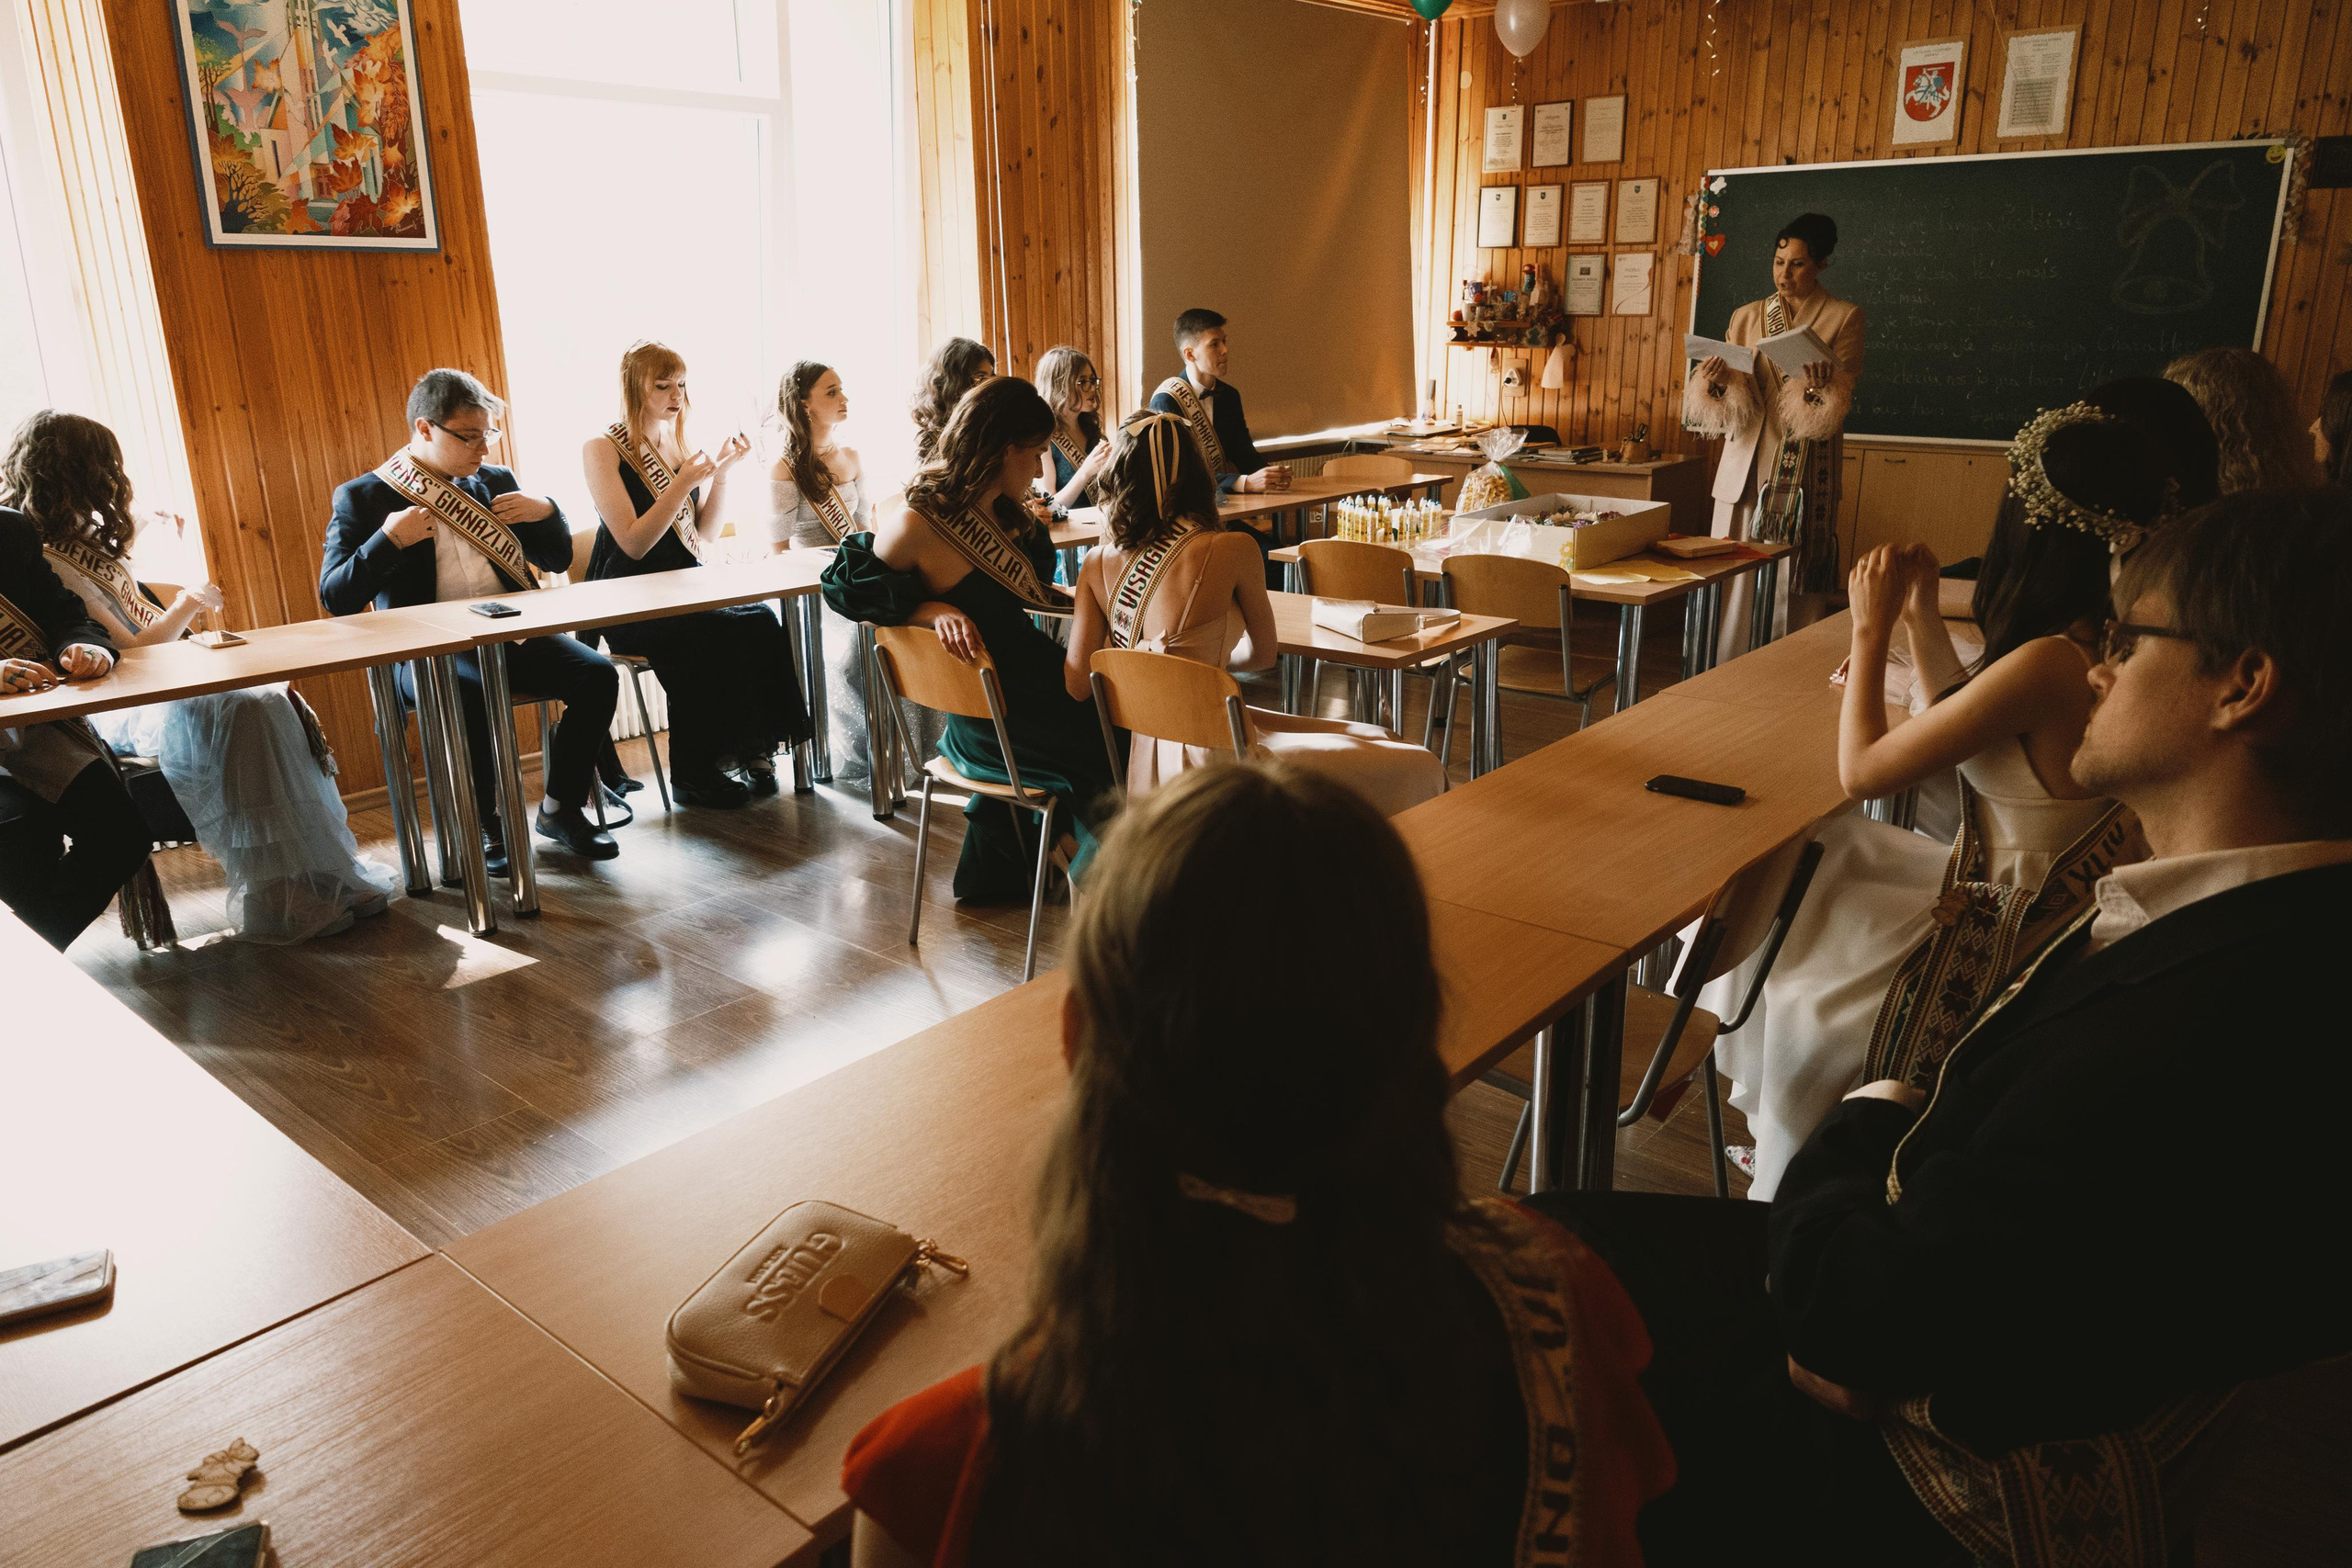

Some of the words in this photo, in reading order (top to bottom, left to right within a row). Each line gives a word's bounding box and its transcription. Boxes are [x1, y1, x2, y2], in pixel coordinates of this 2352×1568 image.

[1192, 411, 1222, 470] GIMNAZIJA
[435, 490, 516, 563] GIMNAZIJA
[120, 581, 159, 627] GIMNA
[746, 1231, 845, 1321] GUESS
